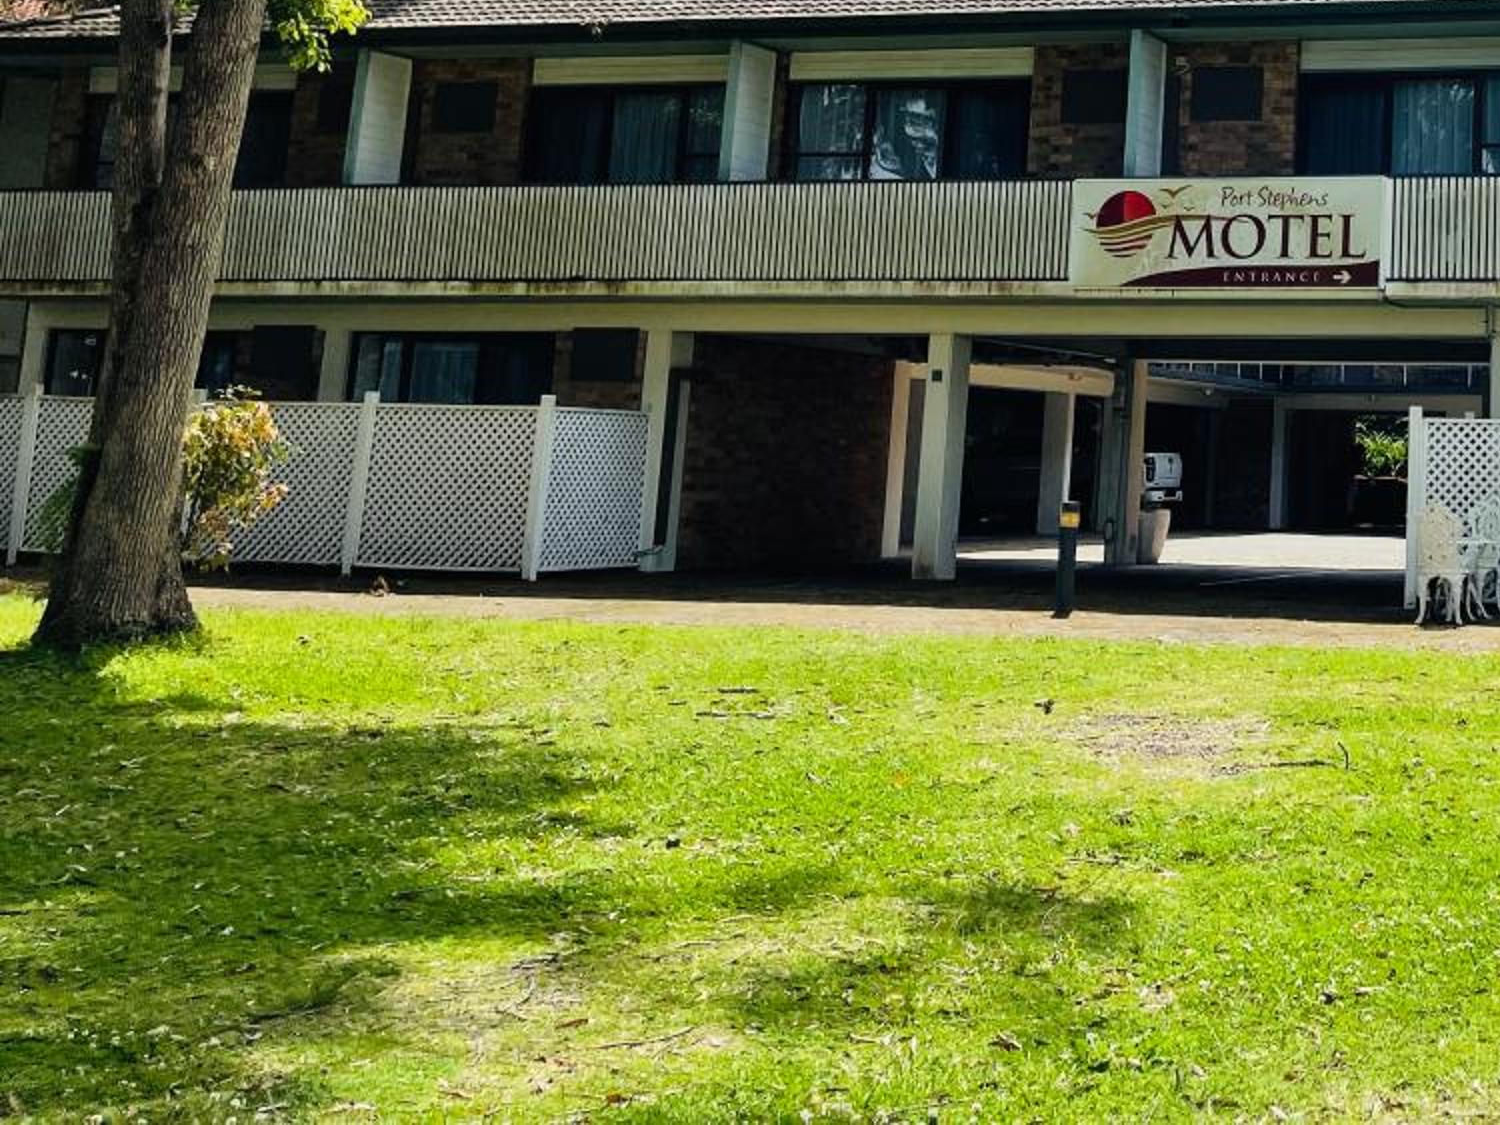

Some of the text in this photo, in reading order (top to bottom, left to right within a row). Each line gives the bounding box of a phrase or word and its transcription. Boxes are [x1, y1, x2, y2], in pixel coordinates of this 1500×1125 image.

[1221, 185, 1329, 210] Port Stephens
[1164, 214, 1367, 260] MOTEL
[1222, 270, 1321, 283] ENTRANCE
